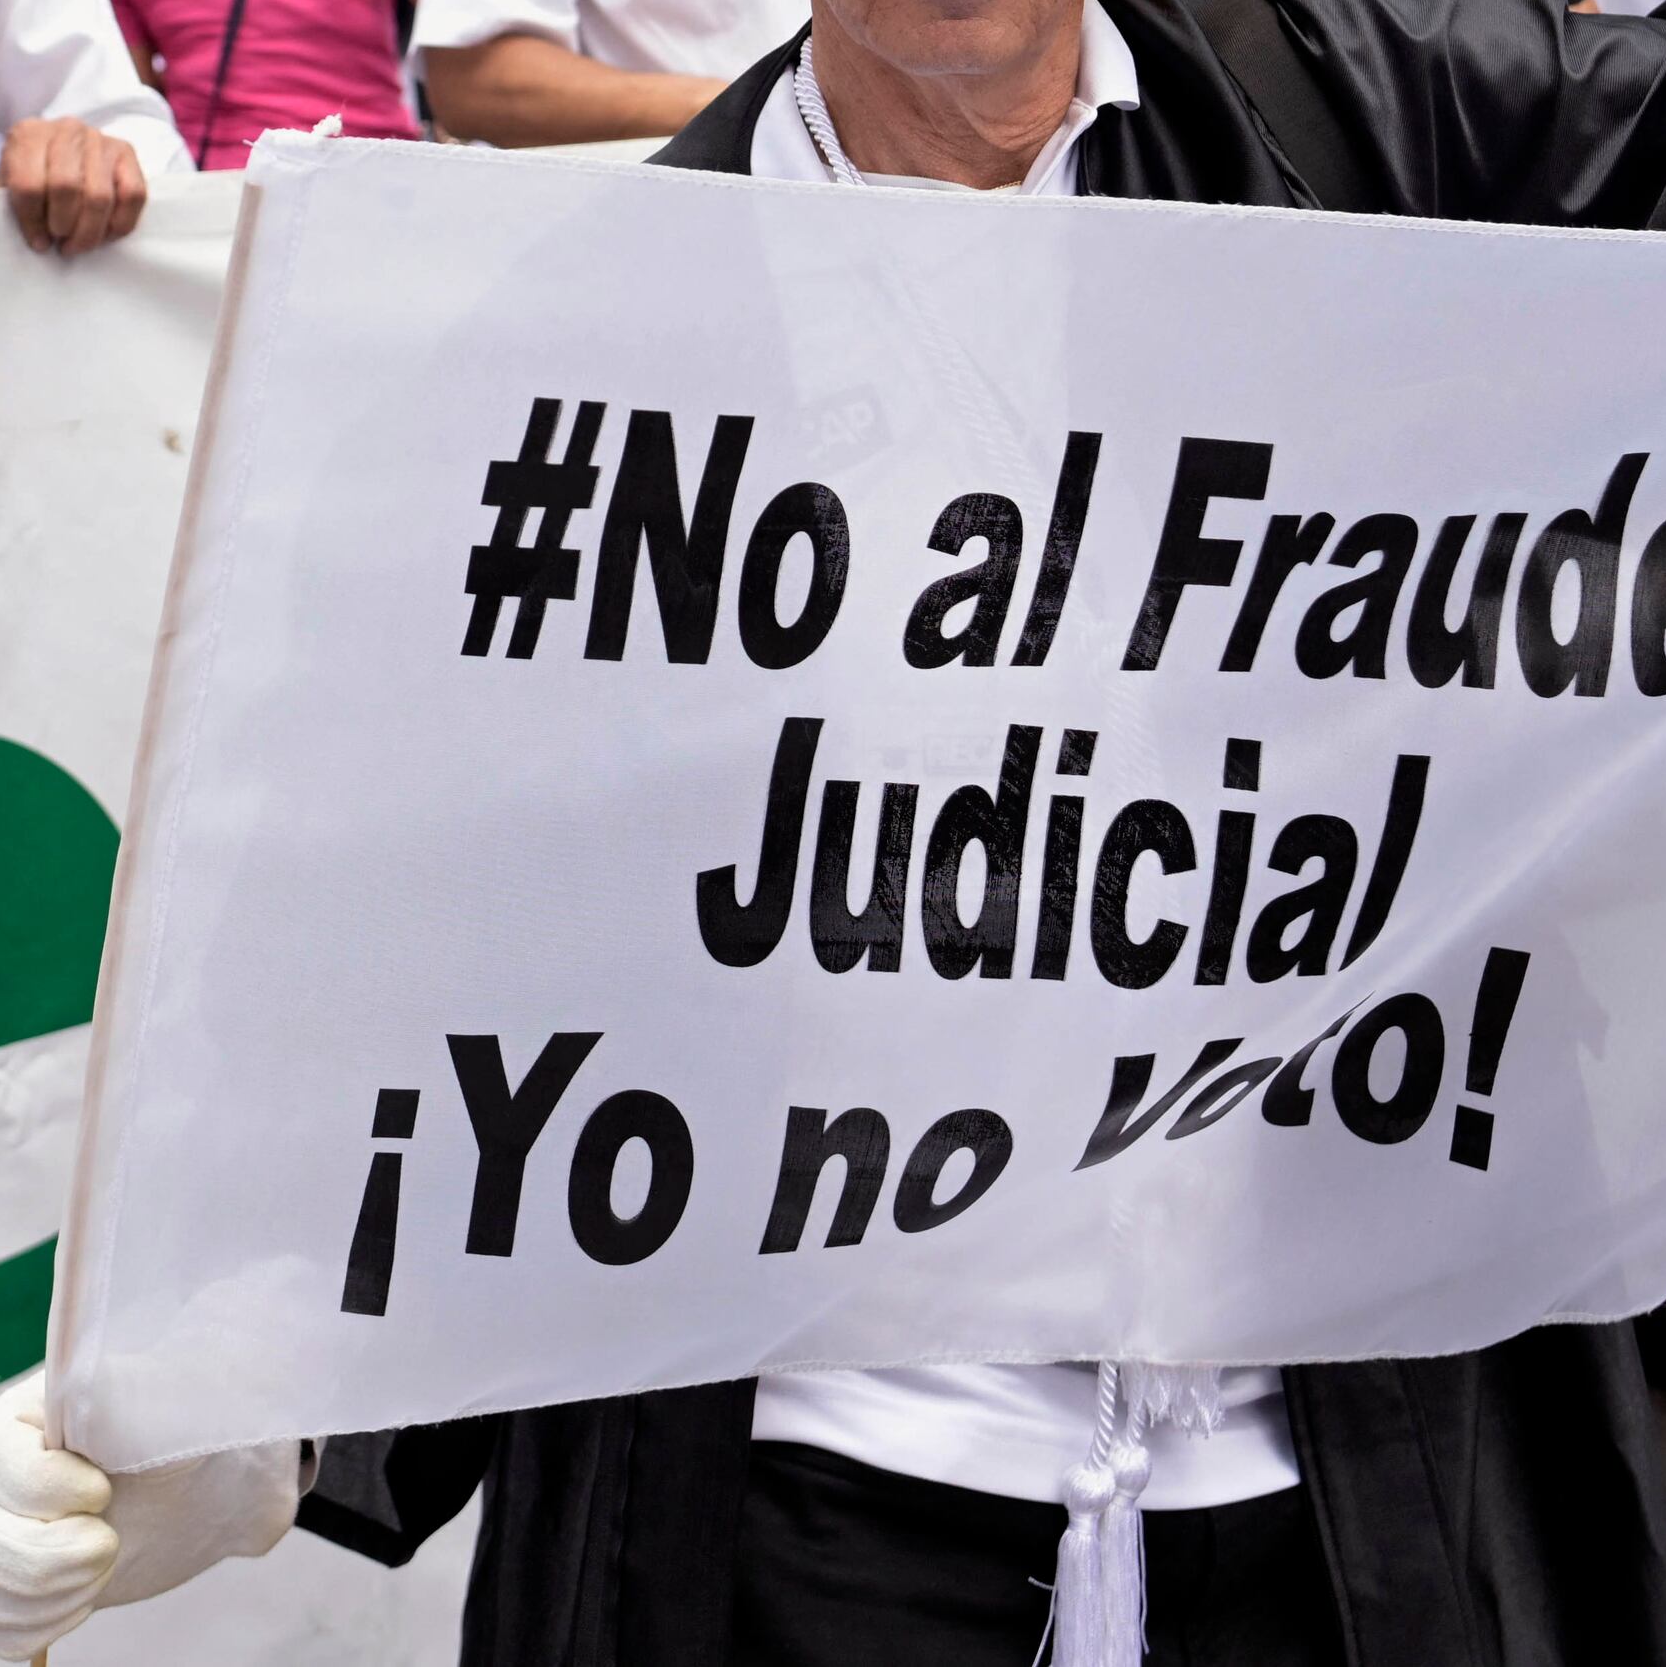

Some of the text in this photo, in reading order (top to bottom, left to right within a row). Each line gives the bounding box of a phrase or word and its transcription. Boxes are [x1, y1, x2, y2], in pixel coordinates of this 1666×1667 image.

[461, 398, 849, 670] #No
[904, 431, 1102, 669] al
[696, 716, 1430, 990] Judicial
[341, 1031, 694, 1317] ¡Yo
[759, 1105, 1013, 1254] no
